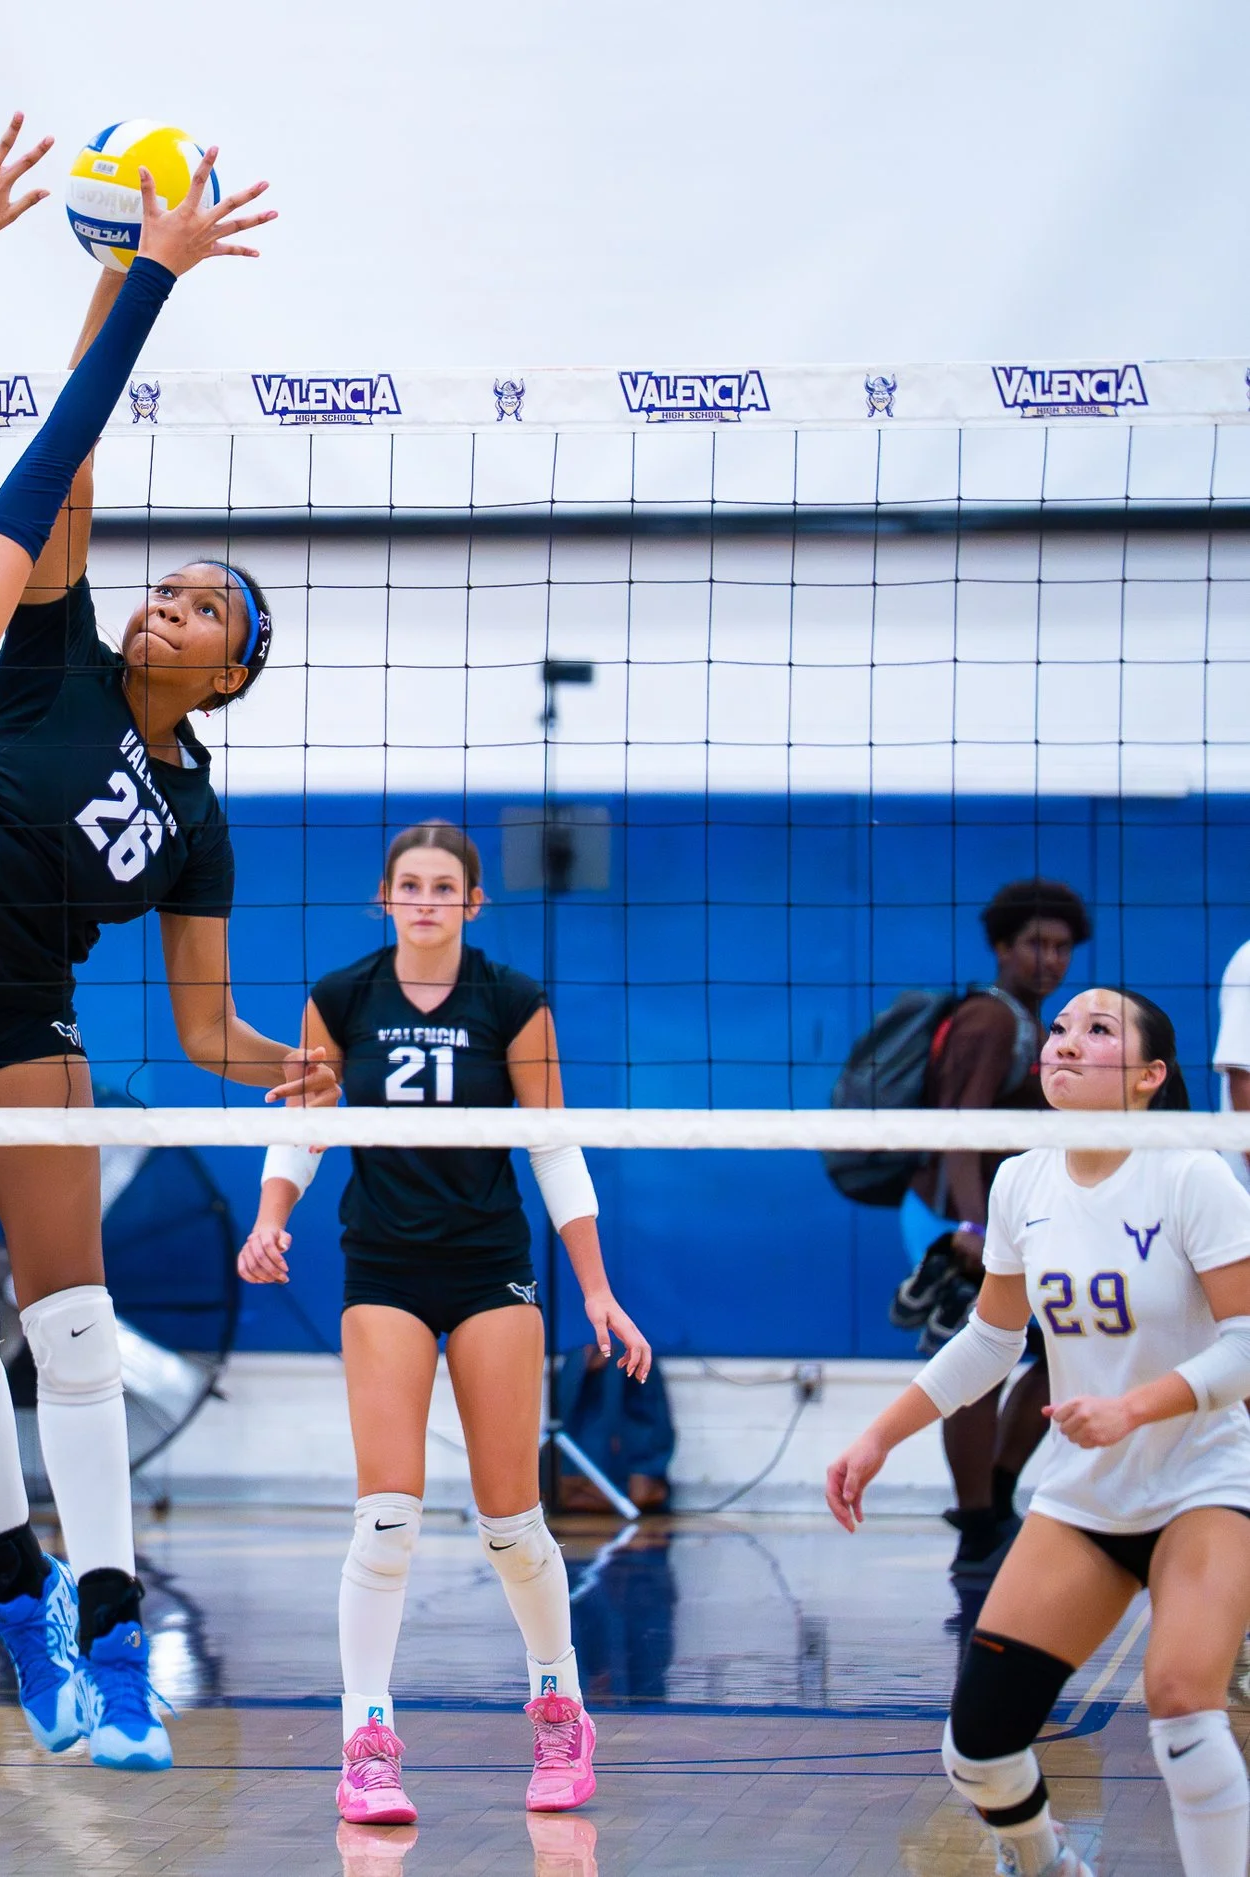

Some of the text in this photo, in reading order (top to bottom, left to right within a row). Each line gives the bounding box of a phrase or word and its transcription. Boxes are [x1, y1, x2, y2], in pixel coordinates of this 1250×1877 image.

[251, 374, 402, 415] VALENCIA
[618, 370, 771, 412] VALENCIA
[992, 364, 1148, 407] VALENCIA
[74, 771, 163, 882] 26
[385, 1046, 454, 1103] 21
[1038, 1269, 1137, 1338] 29
